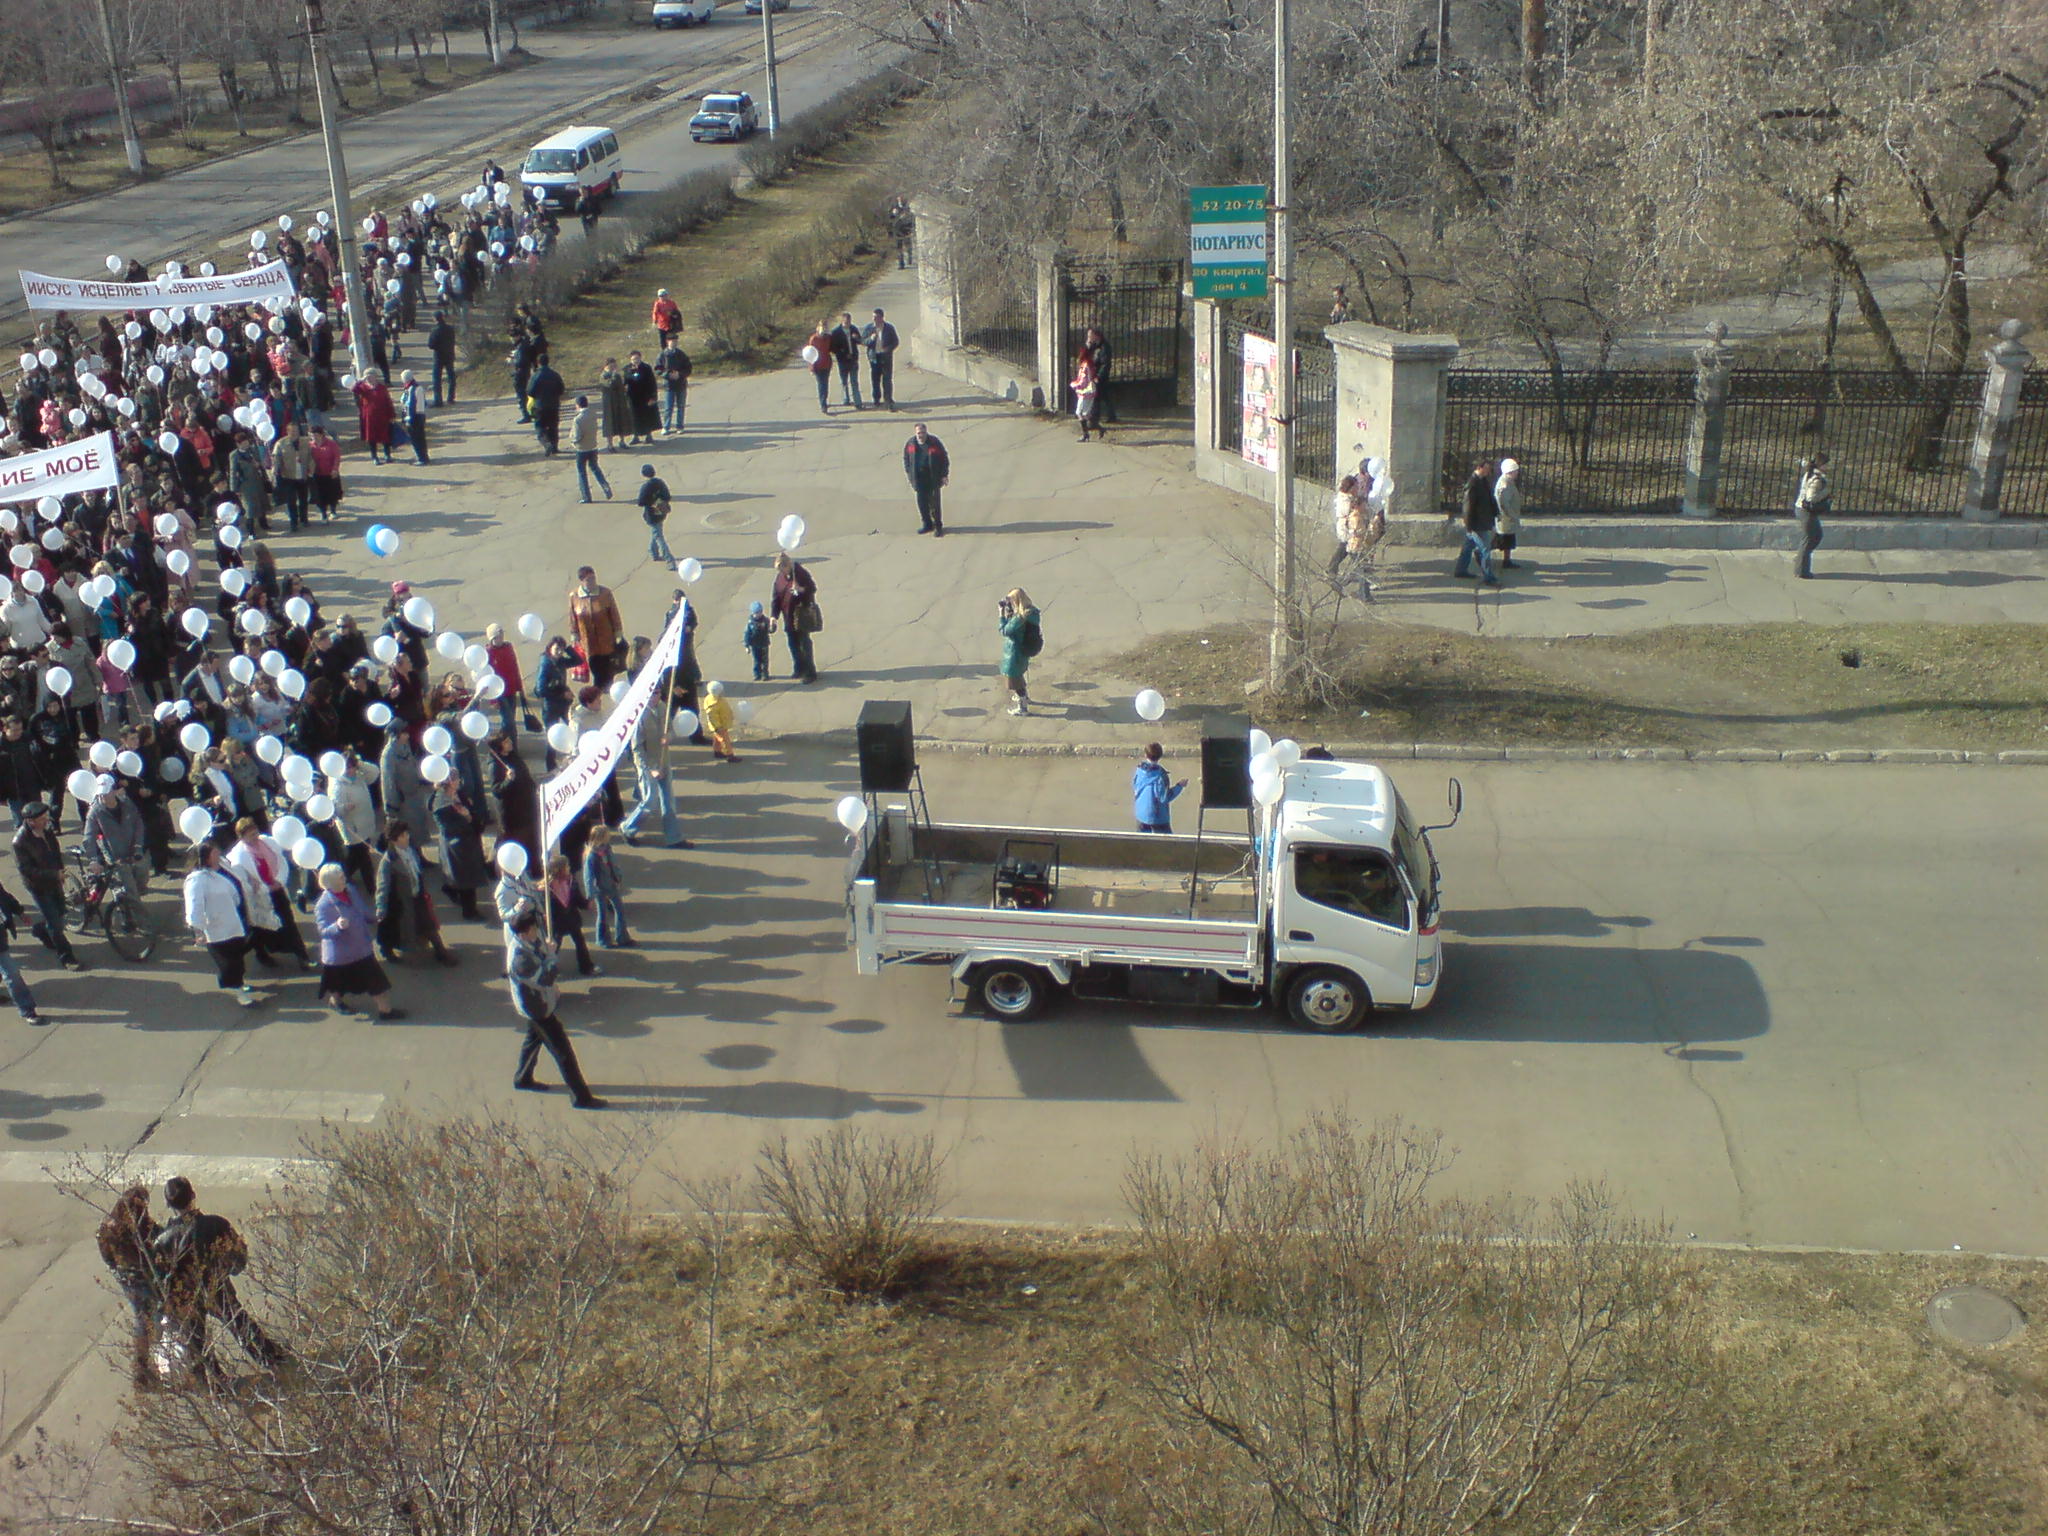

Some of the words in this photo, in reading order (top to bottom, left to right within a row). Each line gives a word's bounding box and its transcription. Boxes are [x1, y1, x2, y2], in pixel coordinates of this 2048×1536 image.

[1192, 234, 1265, 251] НОТАРИУС
[27, 280, 72, 296] ИИСУС
[232, 270, 286, 288] СЕРДЦА
[0, 466, 36, 488] ИЕ
[45, 449, 100, 477] МОЁ
